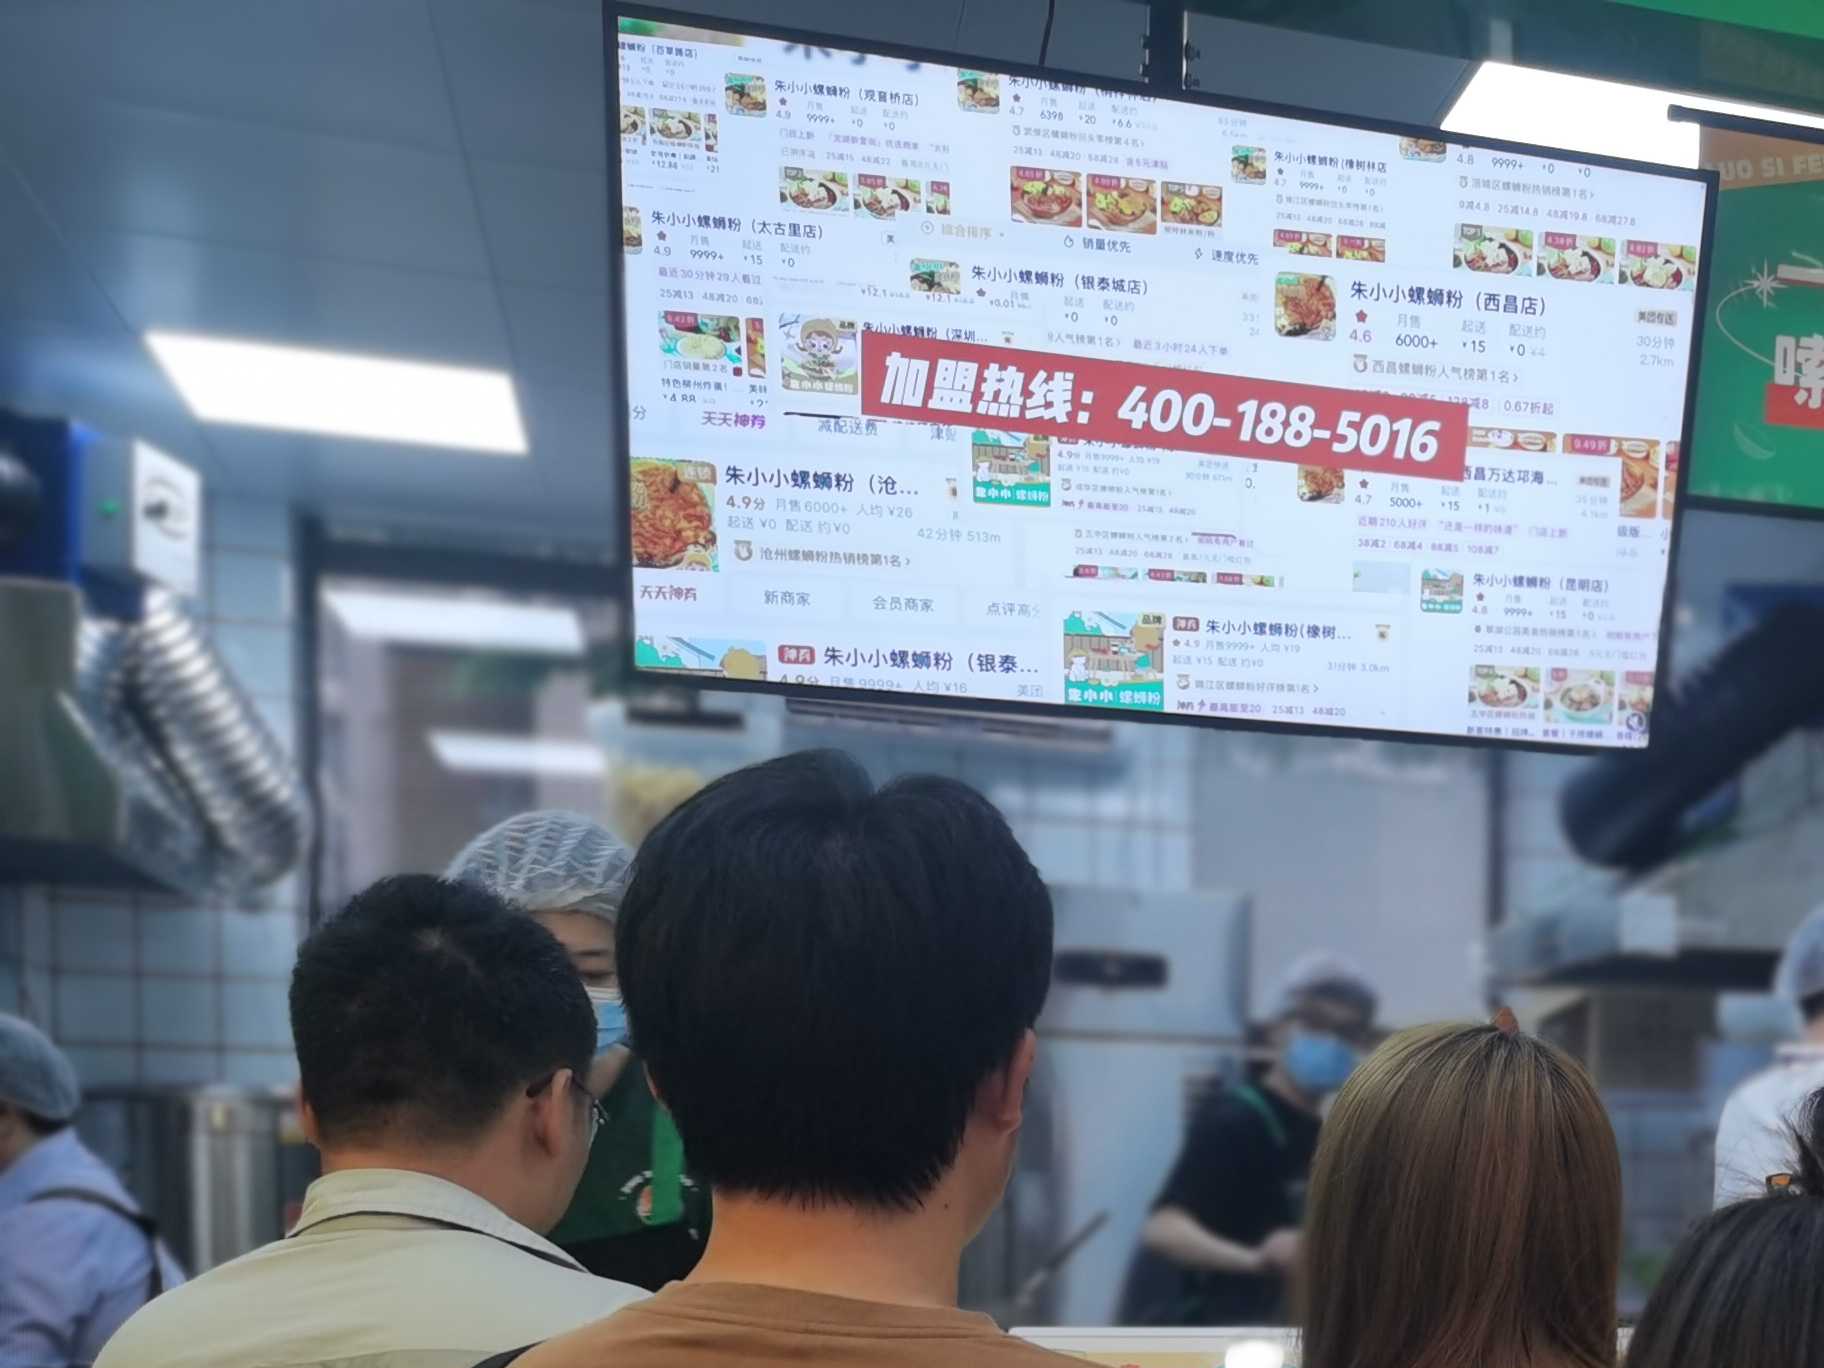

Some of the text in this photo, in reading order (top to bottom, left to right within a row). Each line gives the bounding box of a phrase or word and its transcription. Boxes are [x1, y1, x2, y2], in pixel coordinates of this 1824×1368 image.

[774, 80, 919, 107] 朱小小螺蛳粉（观音桥店）
[806, 113, 835, 124] 9999+
[1456, 154, 1474, 166] 4.8
[1491, 157, 1524, 170] 9999+
[1761, 156, 1785, 177] SI
[652, 211, 823, 240] 朱小小螺蛳粉（太古里店）
[654, 246, 671, 257] 4.9
[690, 249, 724, 261] 9999+
[1083, 235, 1132, 254] 销量优先
[1211, 247, 1260, 266] 速度优先
[971, 265, 1149, 296] 朱小小螺蛳粉（银泰城店）
[1350, 280, 1547, 317] 朱小小螺蛳粉（西昌店）
[1397, 313, 1546, 340] 月售 起送 配送约
[1349, 329, 1372, 344] 4.6
[1395, 333, 1439, 350] 6000+
[1462, 339, 1486, 354] ¥15
[1636, 334, 1675, 351] 30分钟
[1639, 353, 1675, 368] 2.7km
[1371, 357, 1510, 385] 西昌螺蛳粉人气榜第1名
[1503, 398, 1554, 416] 0.67折起
[726, 496, 765, 511] 4.9分
[1355, 494, 1372, 506] 4.7
[1390, 496, 1422, 510] 5000+
[917, 527, 1001, 544] 42分钟 513m
[760, 545, 902, 568] 沧州螺蛳粉热销榜第1名
[764, 590, 811, 607] 新商家
[872, 595, 935, 614] 会员商家
